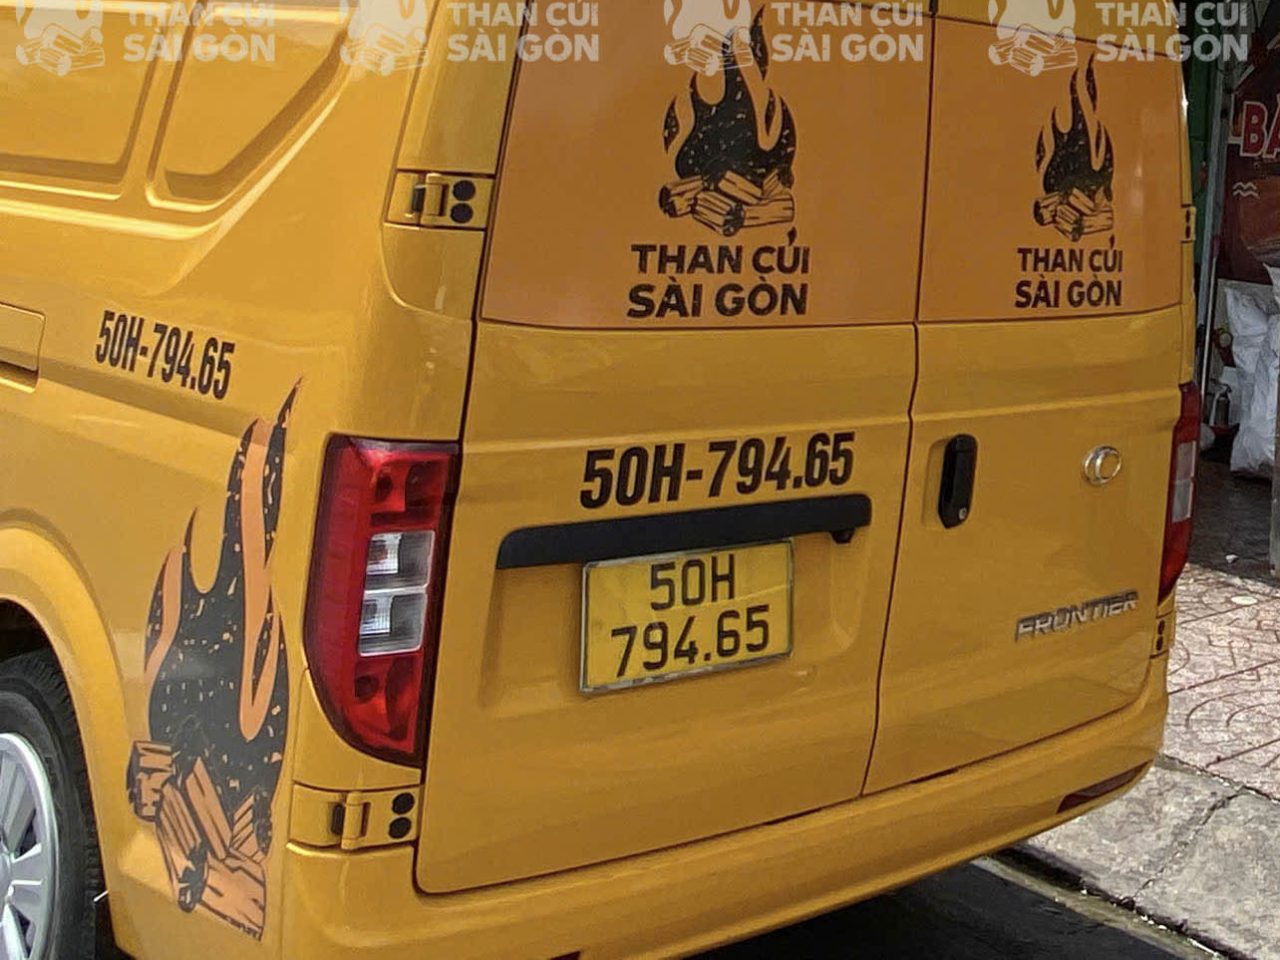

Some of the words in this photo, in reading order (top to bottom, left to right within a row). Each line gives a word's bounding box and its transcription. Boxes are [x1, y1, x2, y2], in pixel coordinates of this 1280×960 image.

[631, 243, 742, 275] THAN
[751, 227, 810, 275] CỦI
[1017, 247, 1084, 273] THAN
[1089, 234, 1123, 272] CỦI
[626, 274, 708, 318] SÀI
[715, 271, 809, 317] GÒN
[1015, 273, 1060, 309] SÀI
[1067, 271, 1122, 307] GÒN
[95, 310, 235, 400] 50H-794.65
[580, 431, 856, 510] 50H-794.65
[649, 553, 735, 611] 50H
[610, 603, 770, 678] 794.65
[1014, 590, 1141, 642] FRONTIER
